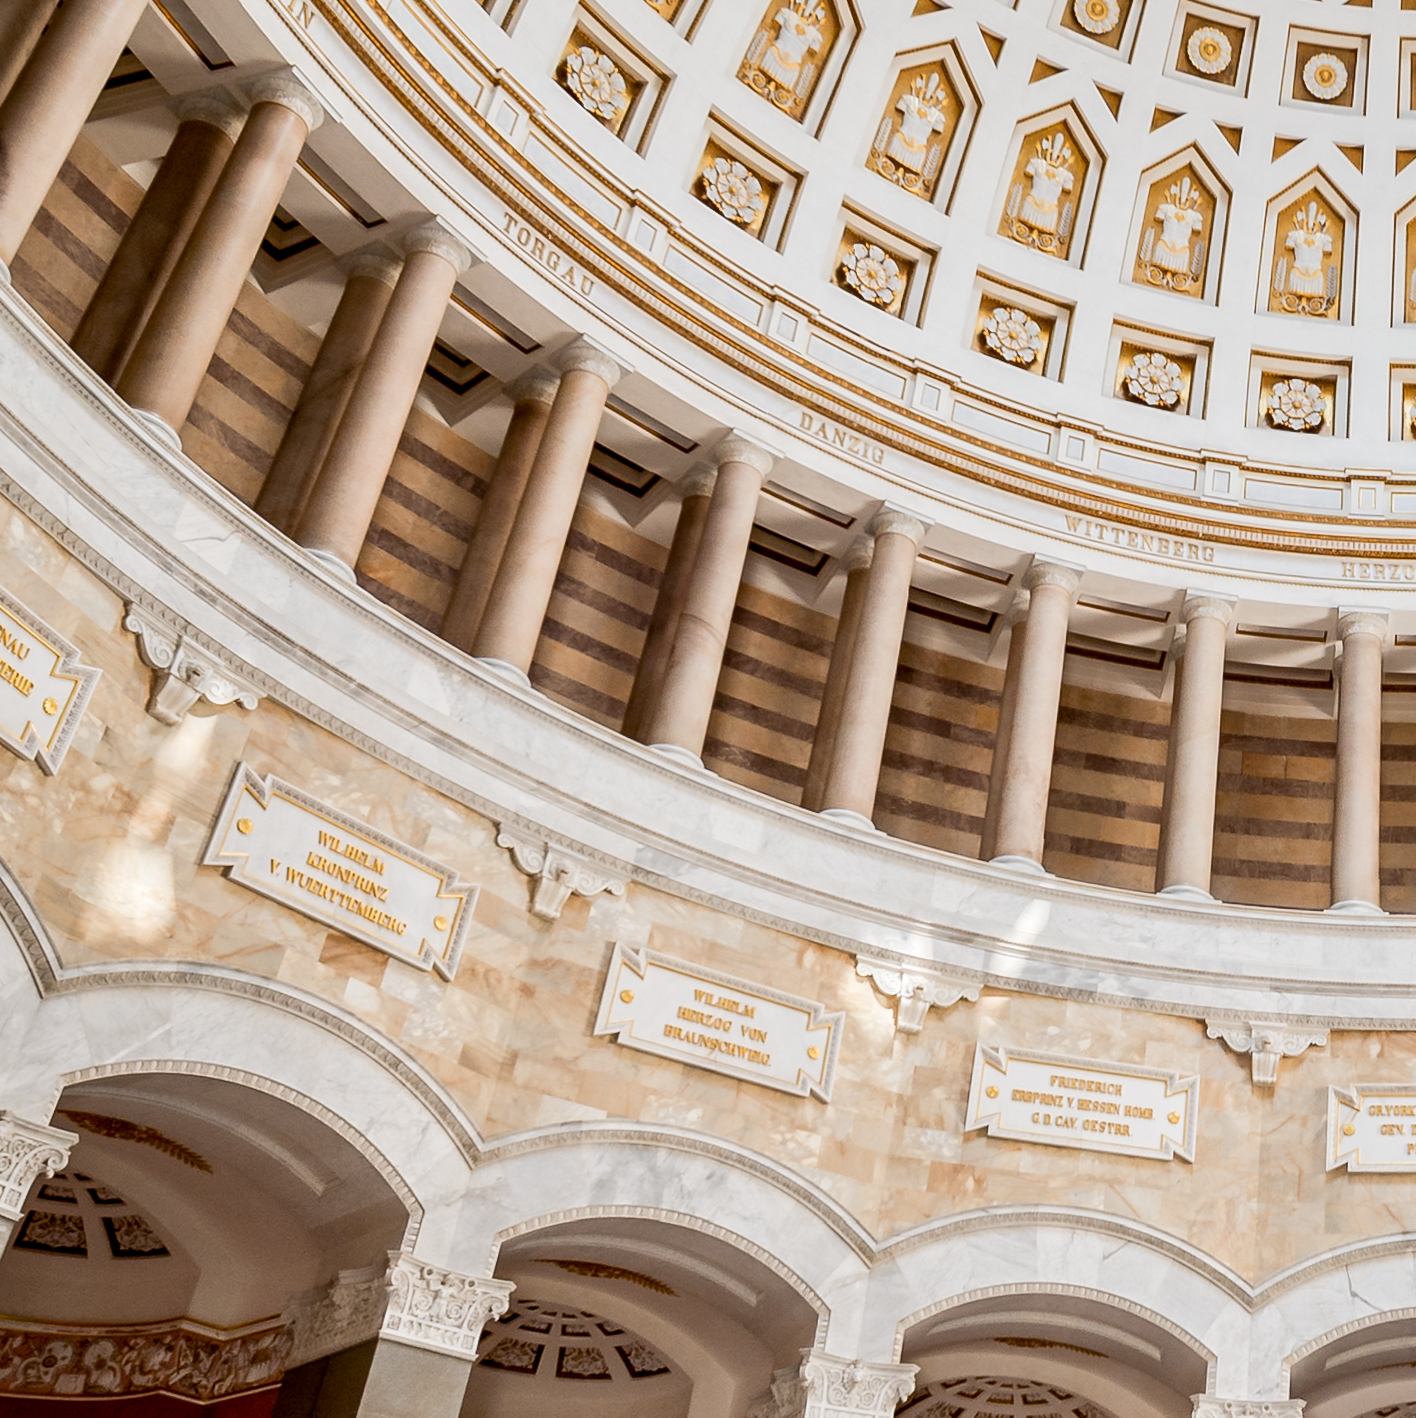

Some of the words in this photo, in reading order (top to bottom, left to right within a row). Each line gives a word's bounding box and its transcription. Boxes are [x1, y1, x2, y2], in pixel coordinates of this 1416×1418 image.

[503, 211, 596, 296] TORGAU
[799, 411, 885, 465] DANZIG
[1064, 514, 1215, 563] WITTENBERG
[306, 851, 390, 902] KRONPRINZ
[318, 830, 387, 876] WILHELM
[286, 866, 407, 936] WUERTTEMBERG
[677, 1006, 733, 1033] HERZOG
[741, 1024, 768, 1044] VON
[694, 989, 756, 1019] WILHELM
[1011, 1089, 1064, 1108] ERBPRINZ
[1077, 1098, 1121, 1116] HESSEN
[1050, 1075, 1123, 1096] FRIEDERICH
